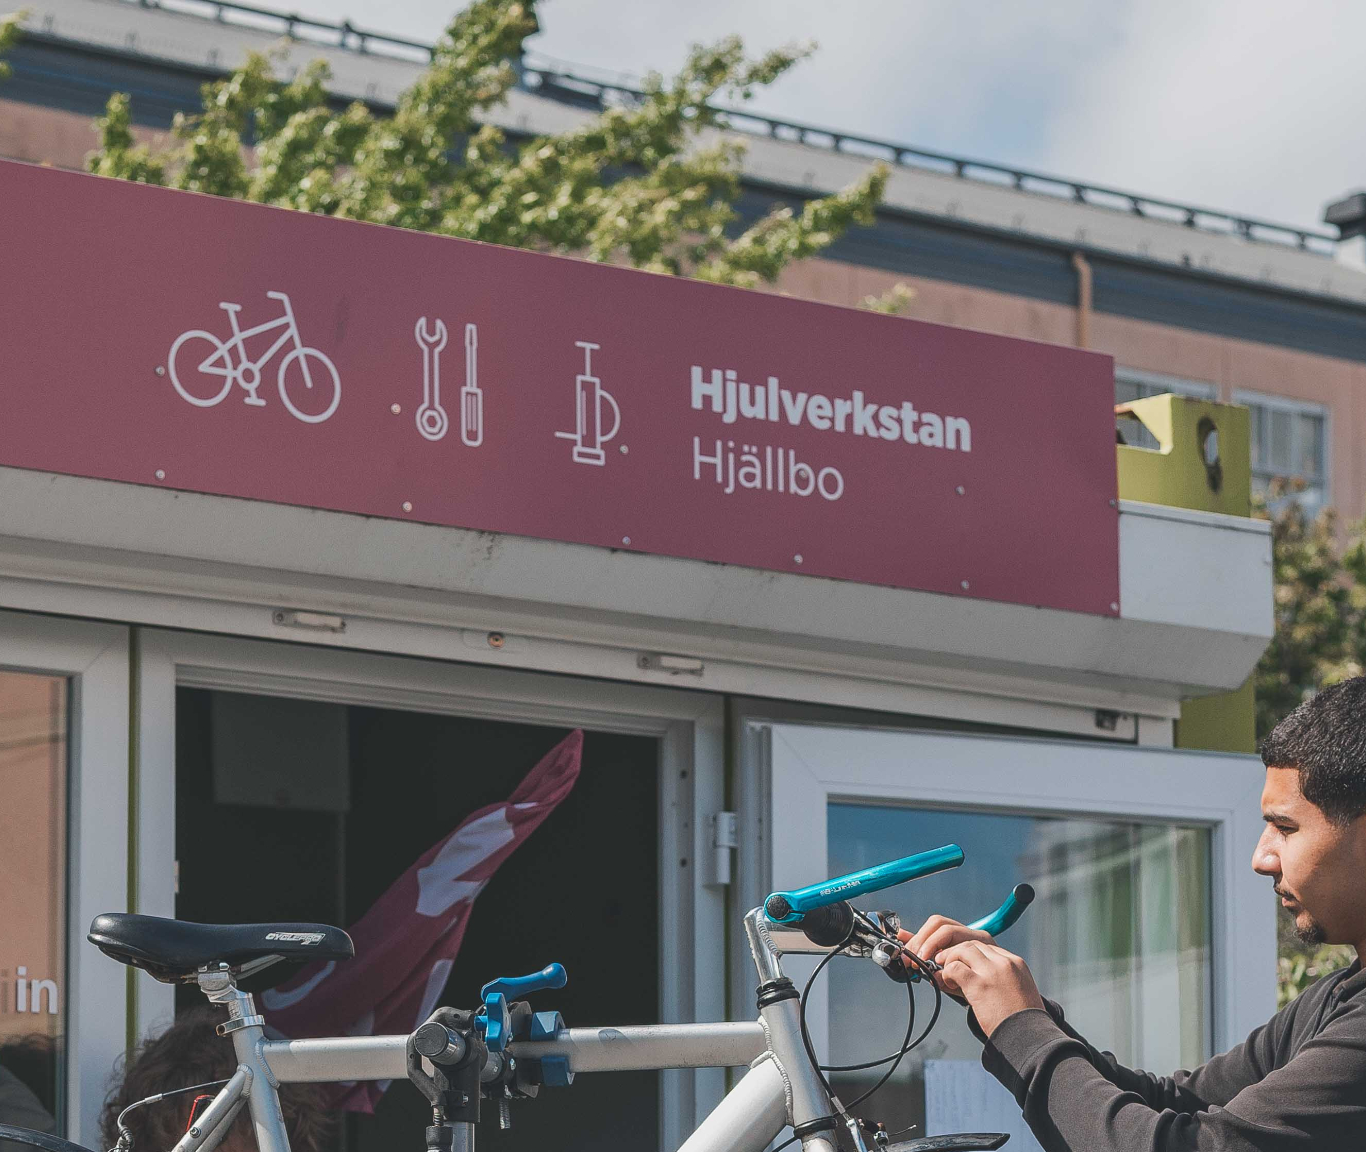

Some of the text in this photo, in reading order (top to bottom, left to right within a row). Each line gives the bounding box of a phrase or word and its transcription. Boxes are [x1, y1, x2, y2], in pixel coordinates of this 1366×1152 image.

[691, 365, 971, 452] Hjulverkstan
[693, 436, 844, 501] Hjällbo
[16, 966, 59, 1015] in
